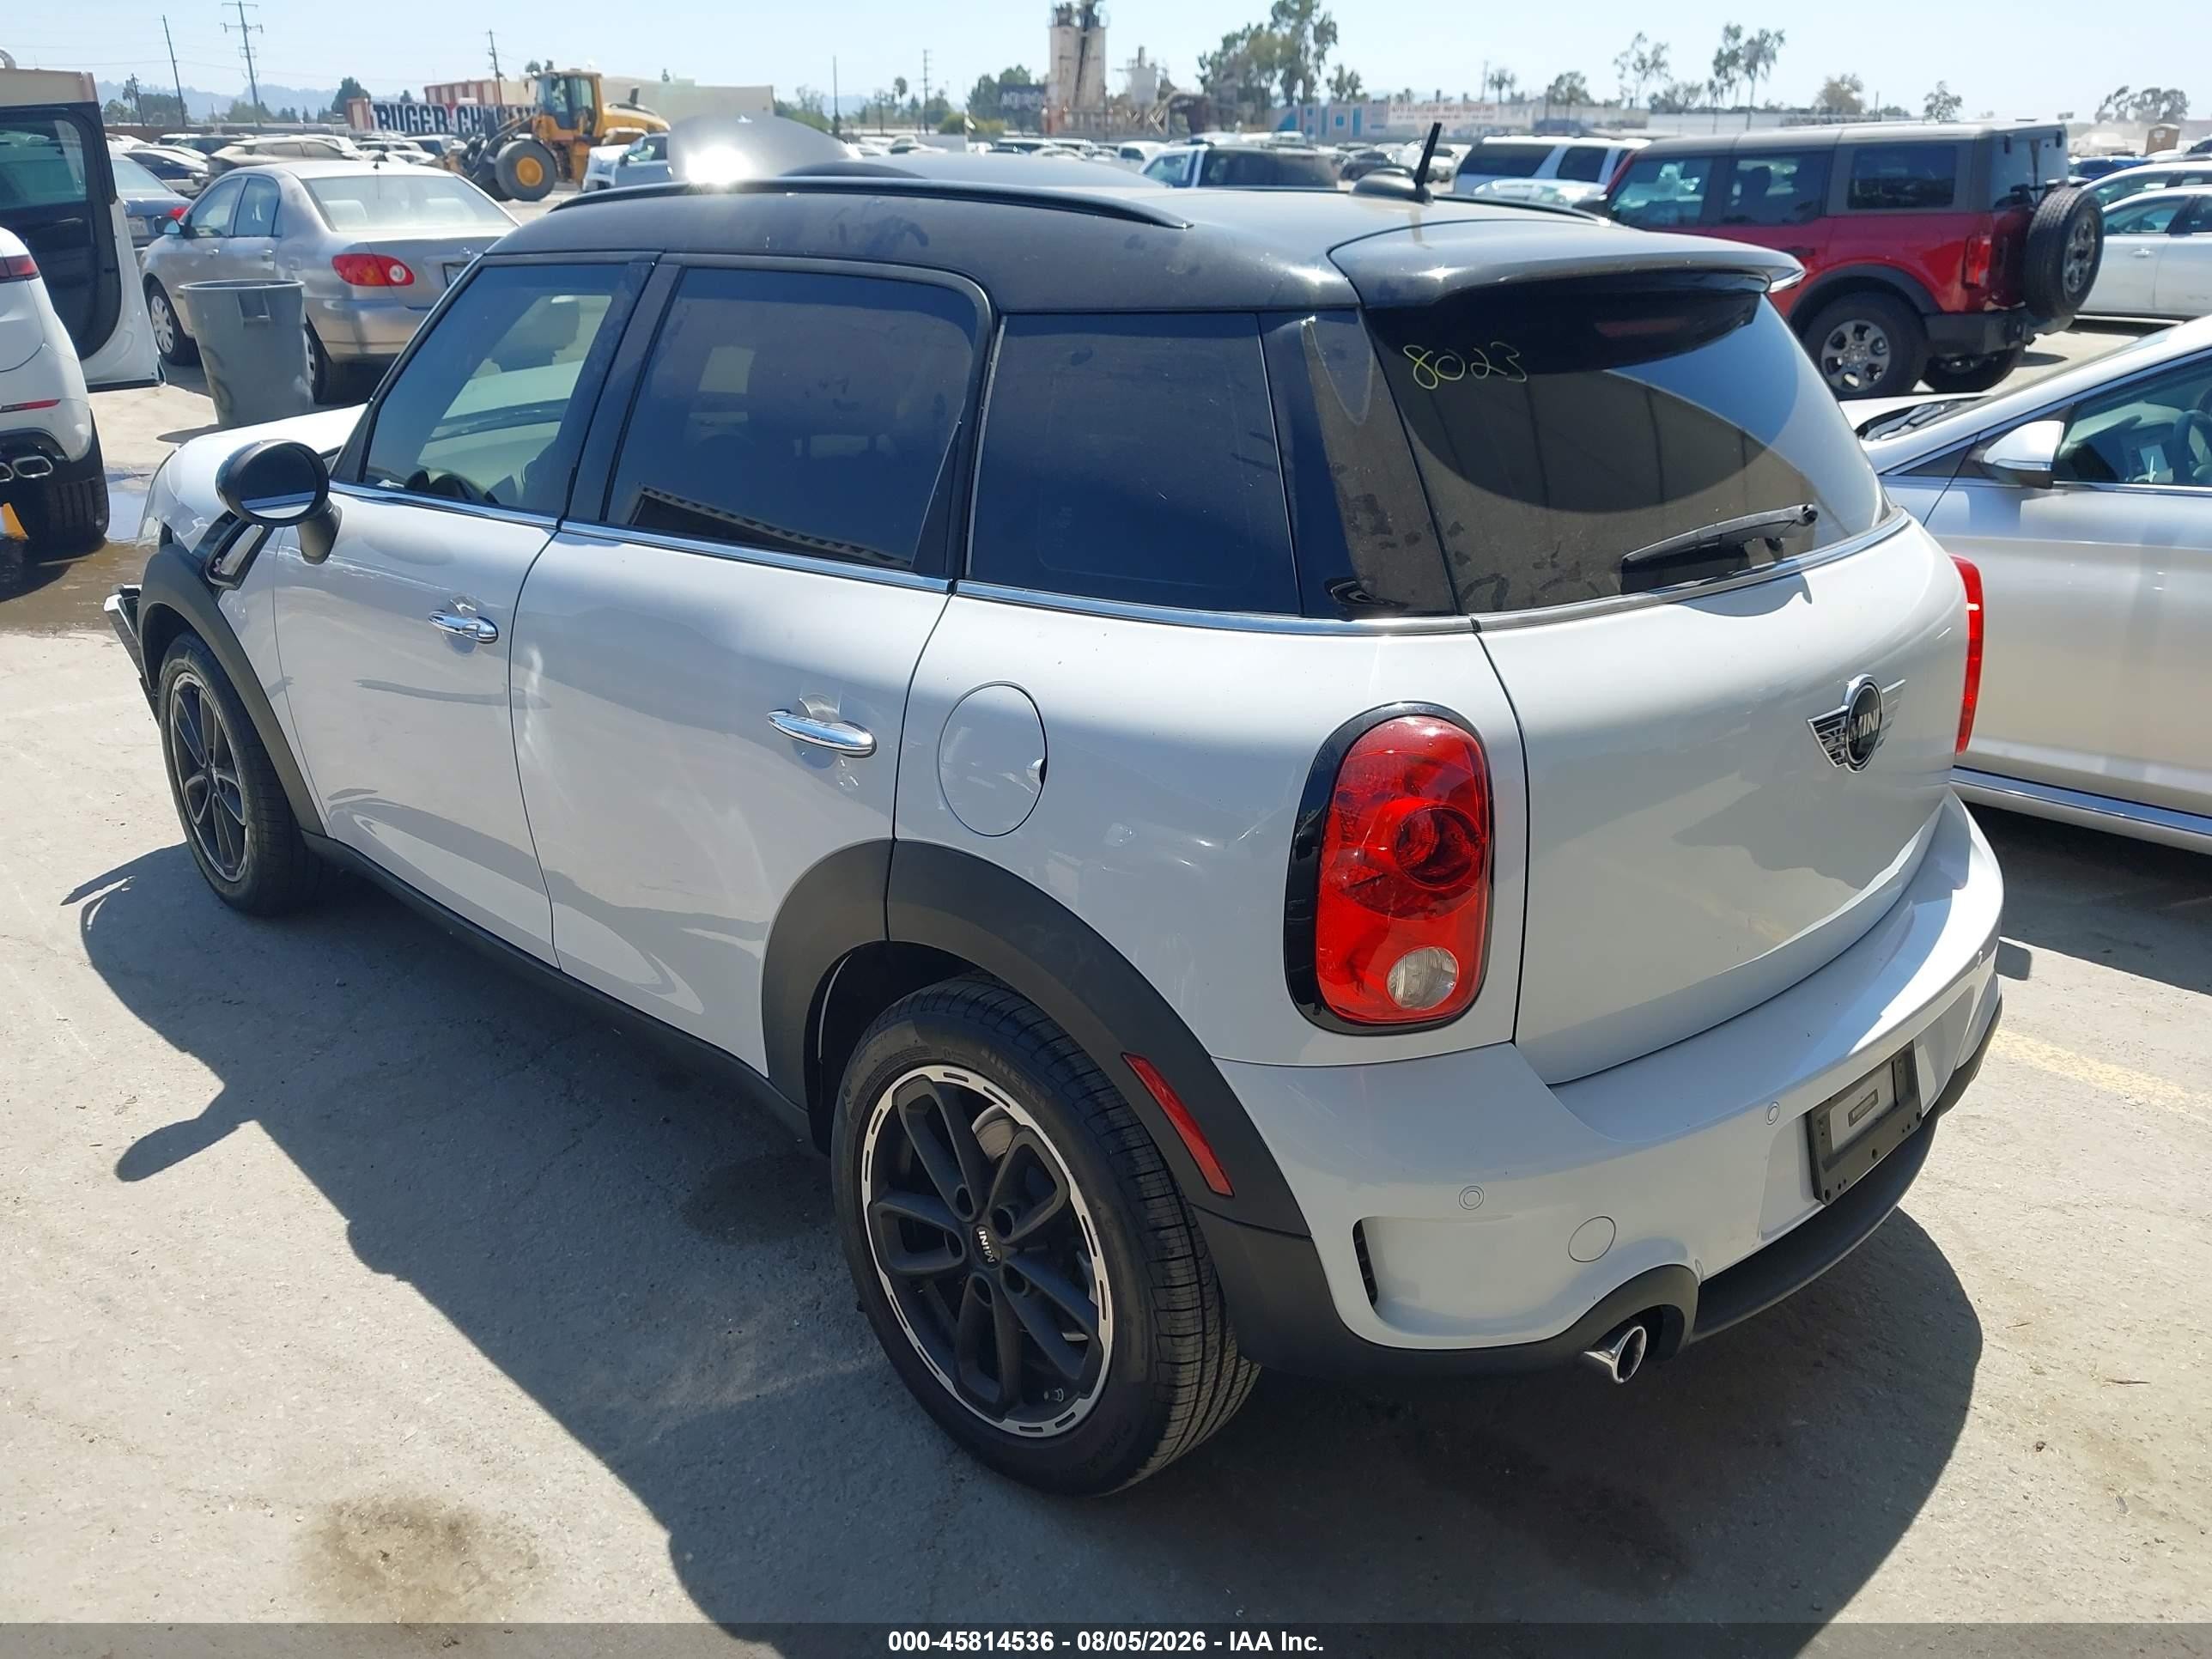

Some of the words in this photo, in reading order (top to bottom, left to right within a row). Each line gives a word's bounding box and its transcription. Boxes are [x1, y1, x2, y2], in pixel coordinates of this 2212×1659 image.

[1402, 341, 1528, 390] 8023
[1849, 707, 1880, 743] MINI
[979, 1230, 996, 1263] MINI
